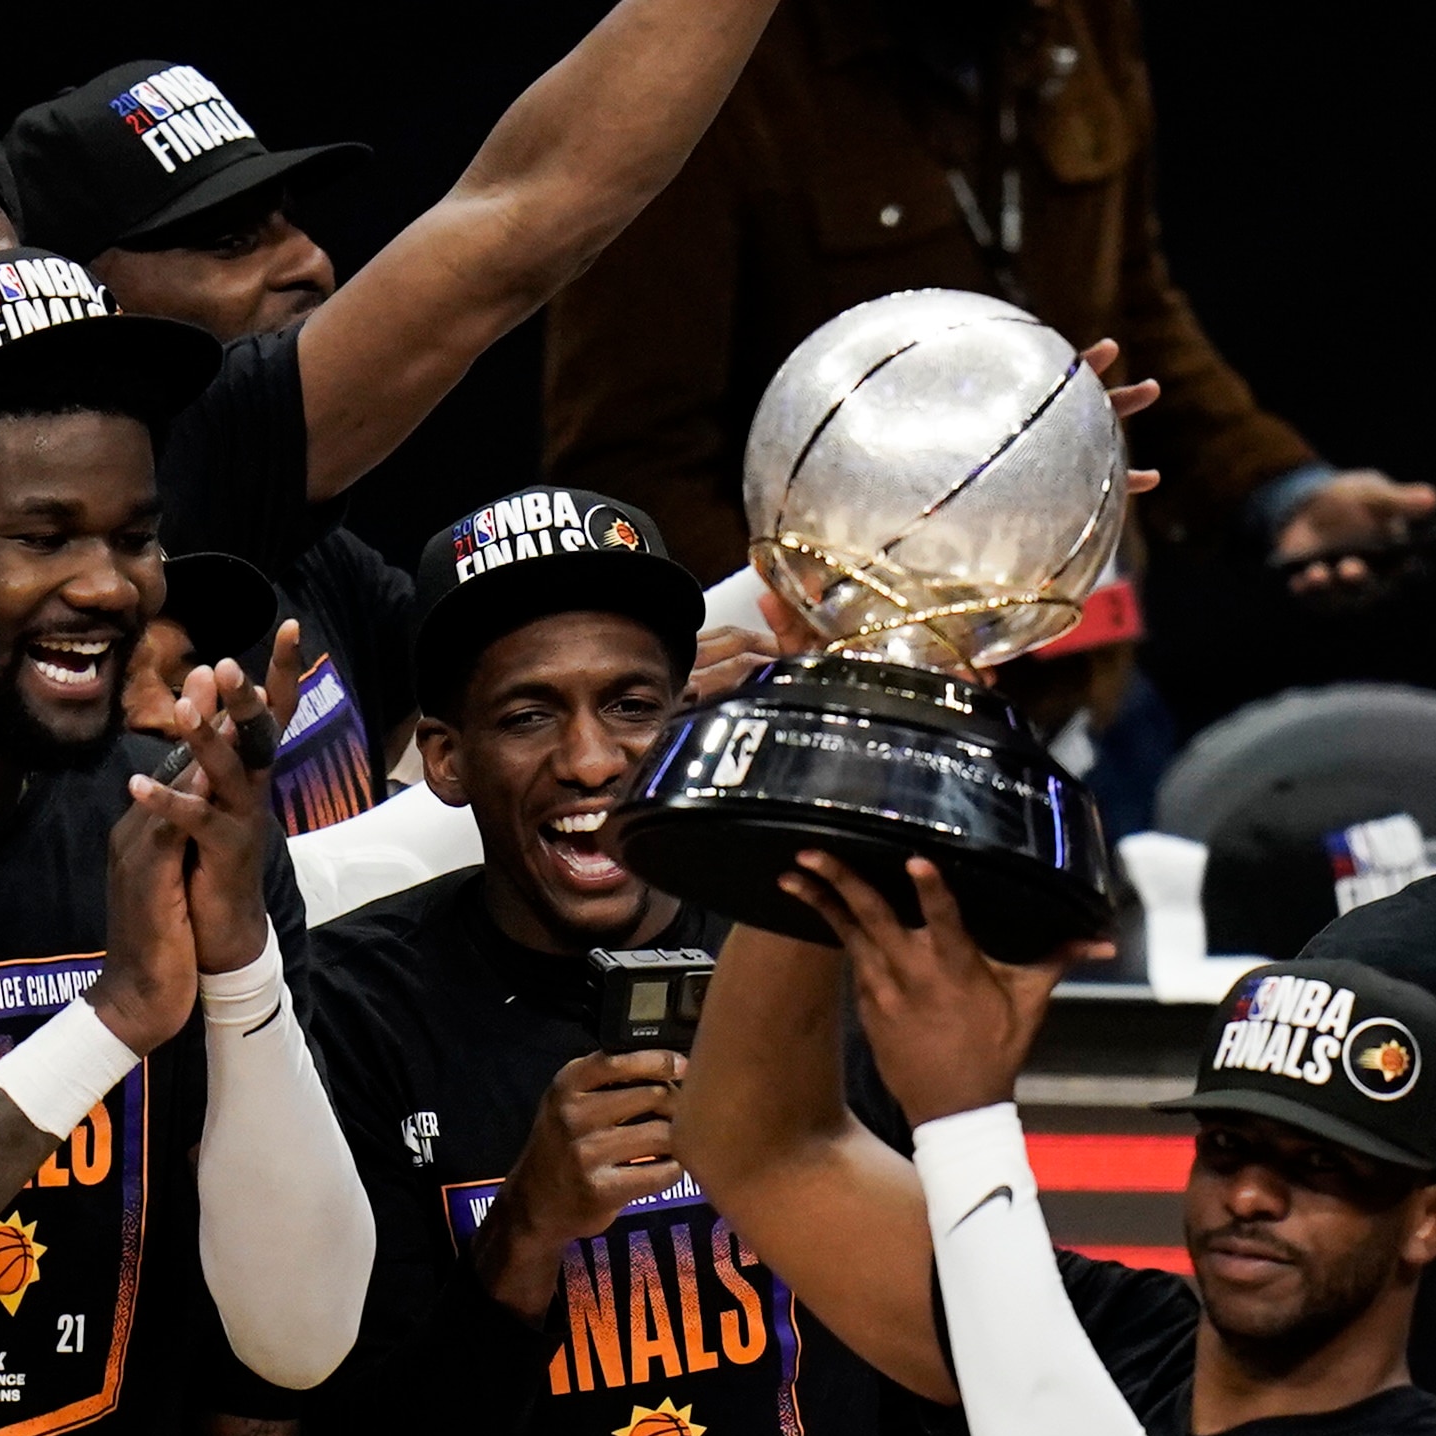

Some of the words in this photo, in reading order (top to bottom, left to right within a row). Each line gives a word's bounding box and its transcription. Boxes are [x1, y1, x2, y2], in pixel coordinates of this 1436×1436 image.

[125, 109, 154, 135] 21
[15, 257, 100, 303] NBA
[494, 491, 582, 539] NBA
[1266, 975, 1356, 1040] NBA
[1213, 1020, 1341, 1086] FINALS
[56, 1314, 85, 1353] 21
